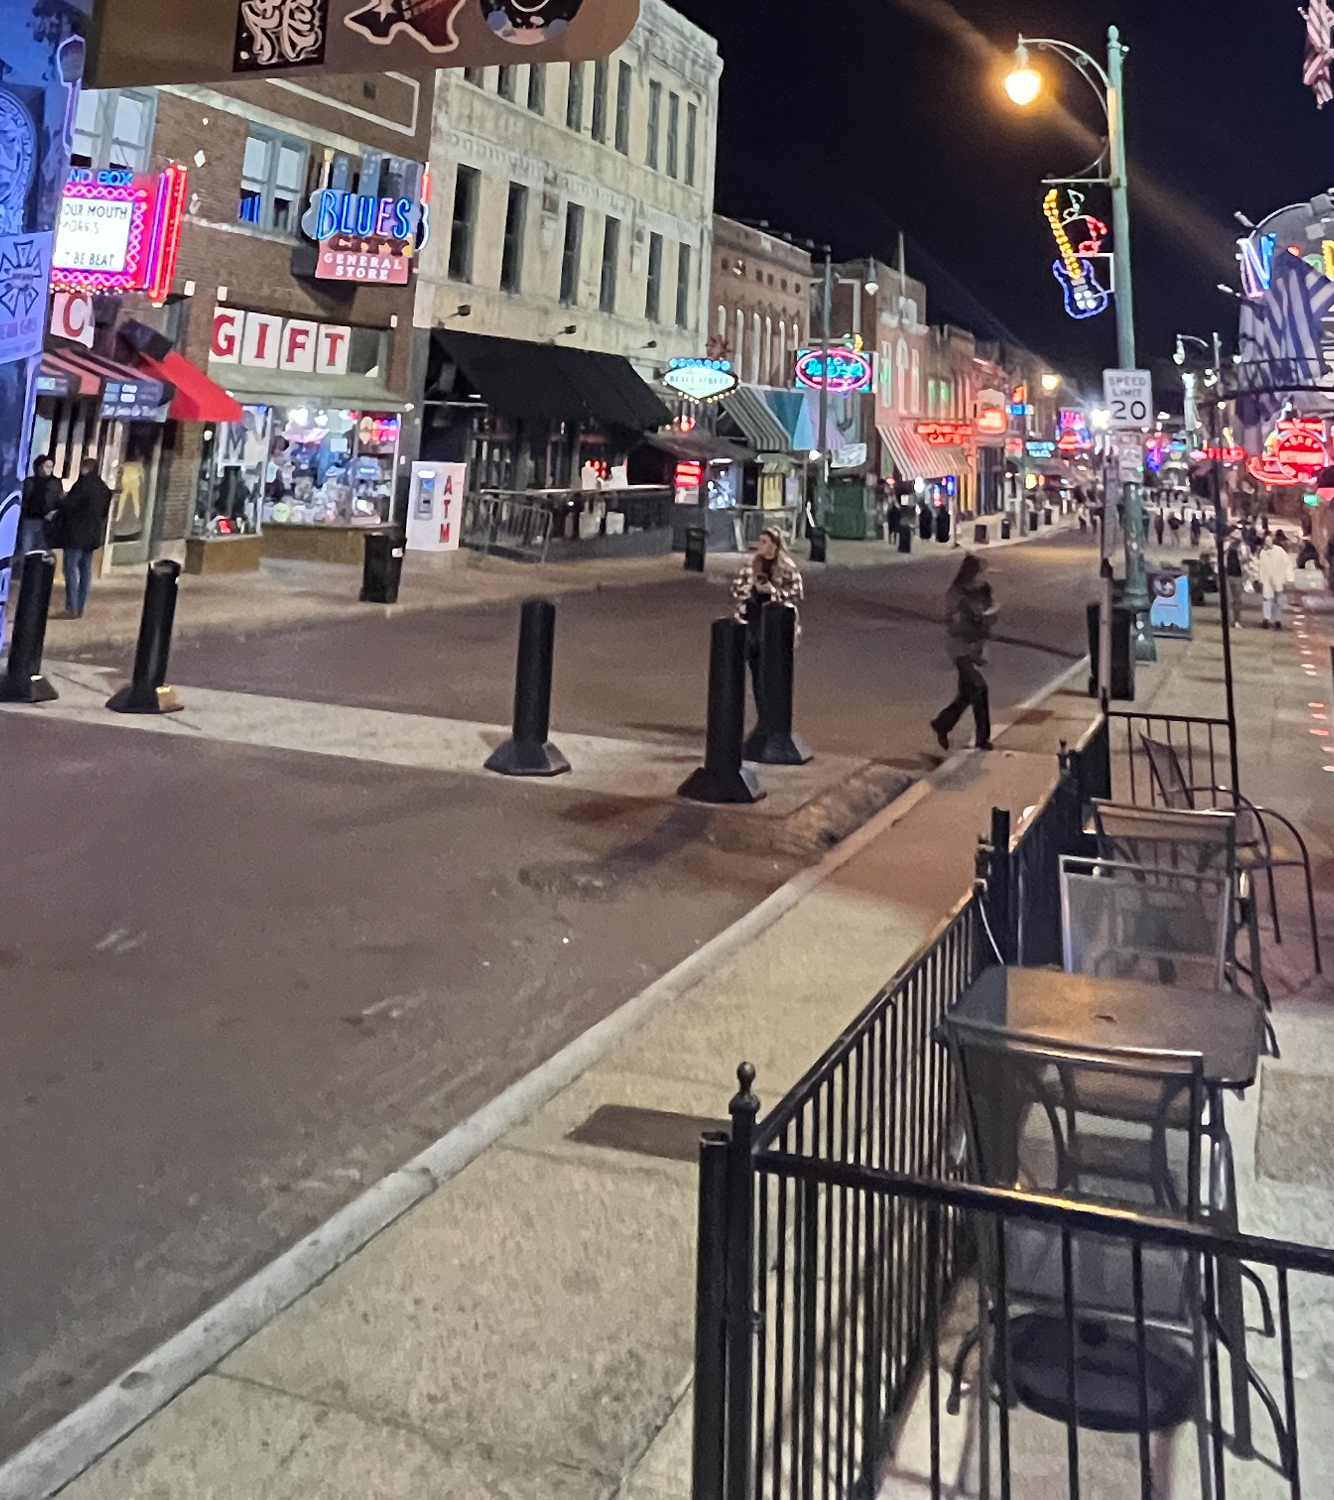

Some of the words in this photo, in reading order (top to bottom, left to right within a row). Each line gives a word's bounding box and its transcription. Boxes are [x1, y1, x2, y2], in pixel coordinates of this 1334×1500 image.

[67, 169, 94, 185] ND
[317, 188, 412, 241] BLUES
[328, 231, 410, 257] CITY
[324, 253, 402, 269] GENERAL
[335, 266, 389, 280] STORE
[212, 313, 345, 367] GIFT
[1108, 376, 1147, 387] SPEED
[1112, 388, 1143, 398] LIMIT
[1111, 401, 1147, 421] 20
[438, 475, 454, 543] ATM
